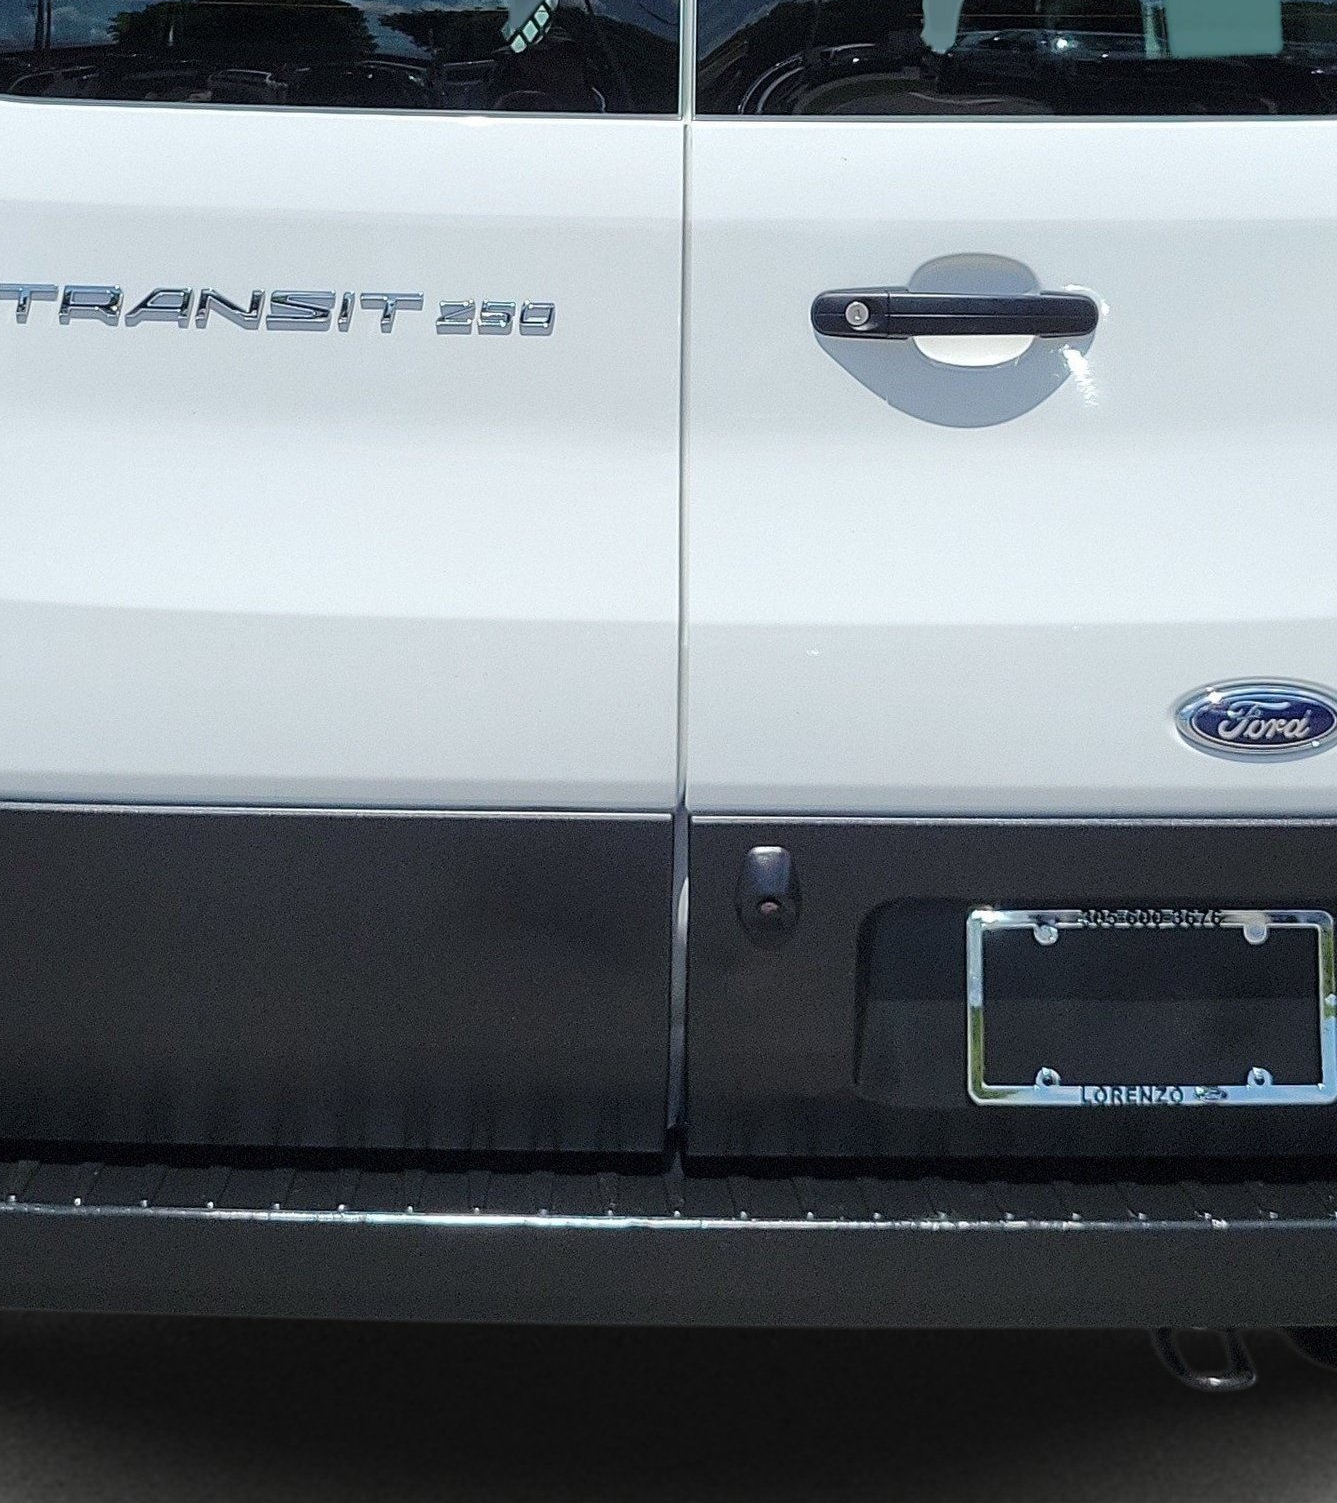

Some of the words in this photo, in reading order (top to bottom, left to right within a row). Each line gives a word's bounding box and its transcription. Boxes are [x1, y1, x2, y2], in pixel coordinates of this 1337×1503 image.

[435, 299, 554, 336] 250
[1218, 700, 1312, 740] Ford
[1080, 1085, 1184, 1105] LORENZO
